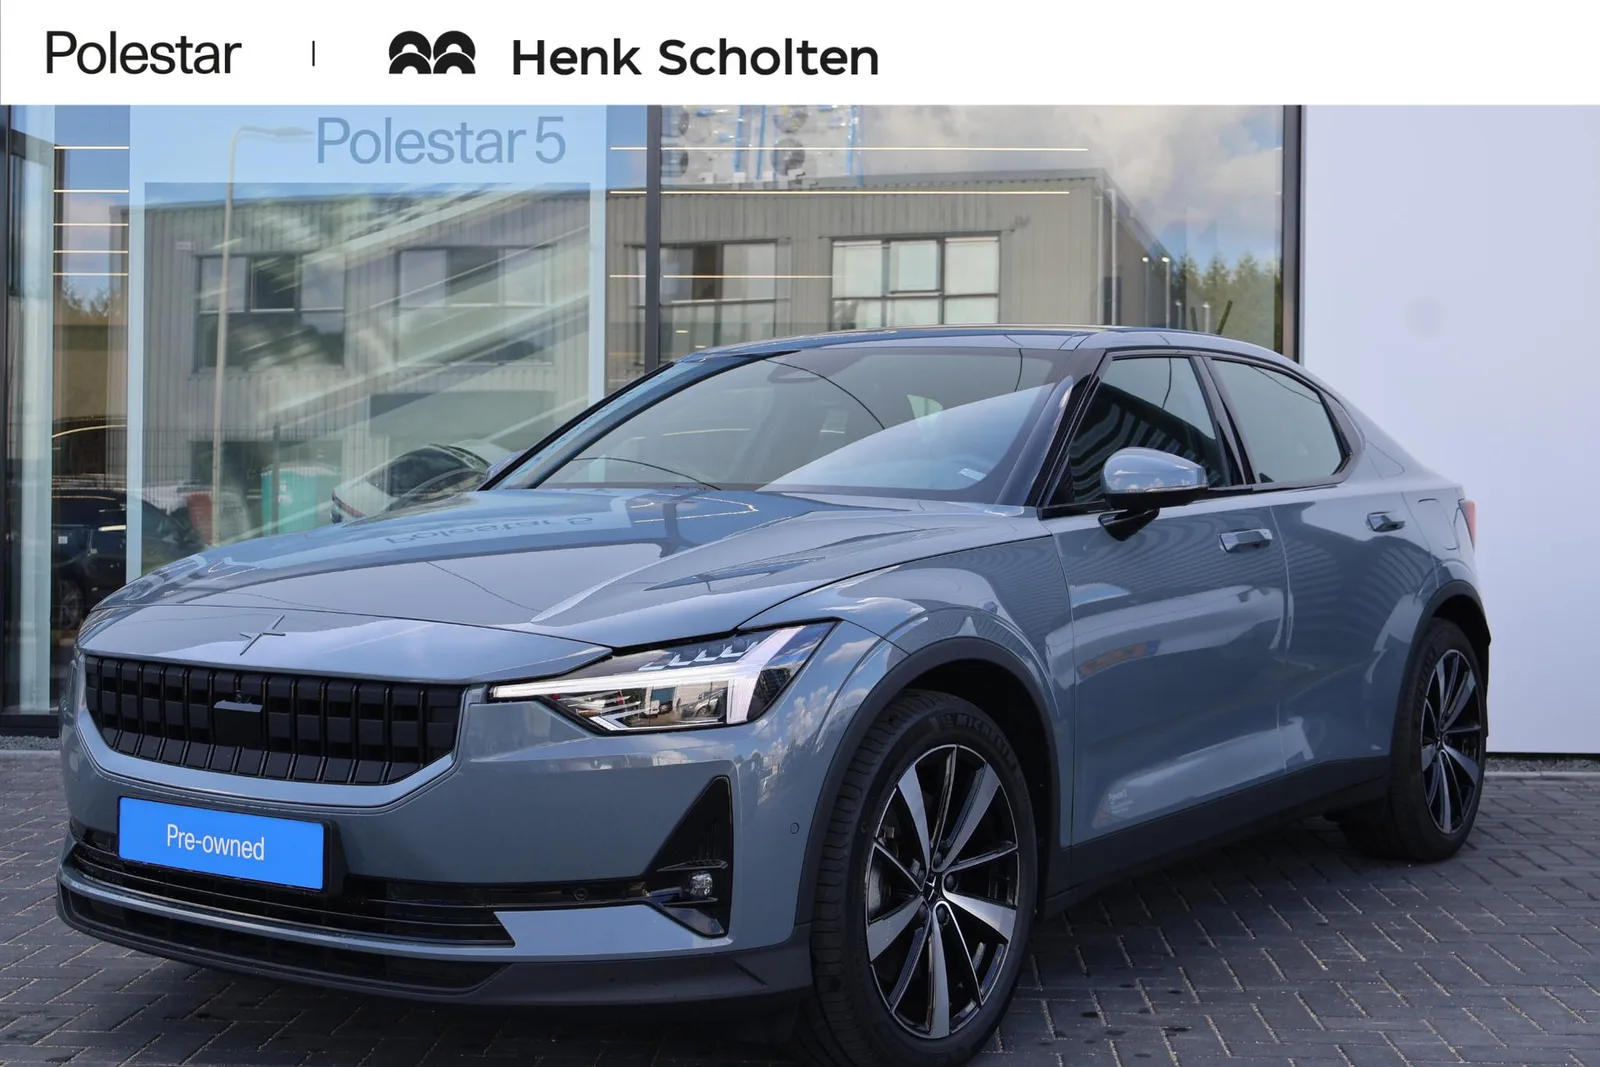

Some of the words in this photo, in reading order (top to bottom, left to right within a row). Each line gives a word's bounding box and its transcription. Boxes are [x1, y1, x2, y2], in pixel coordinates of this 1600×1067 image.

[317, 116, 527, 165] Polestar
[535, 115, 566, 164] 5
[166, 823, 265, 861] Pre-owned
